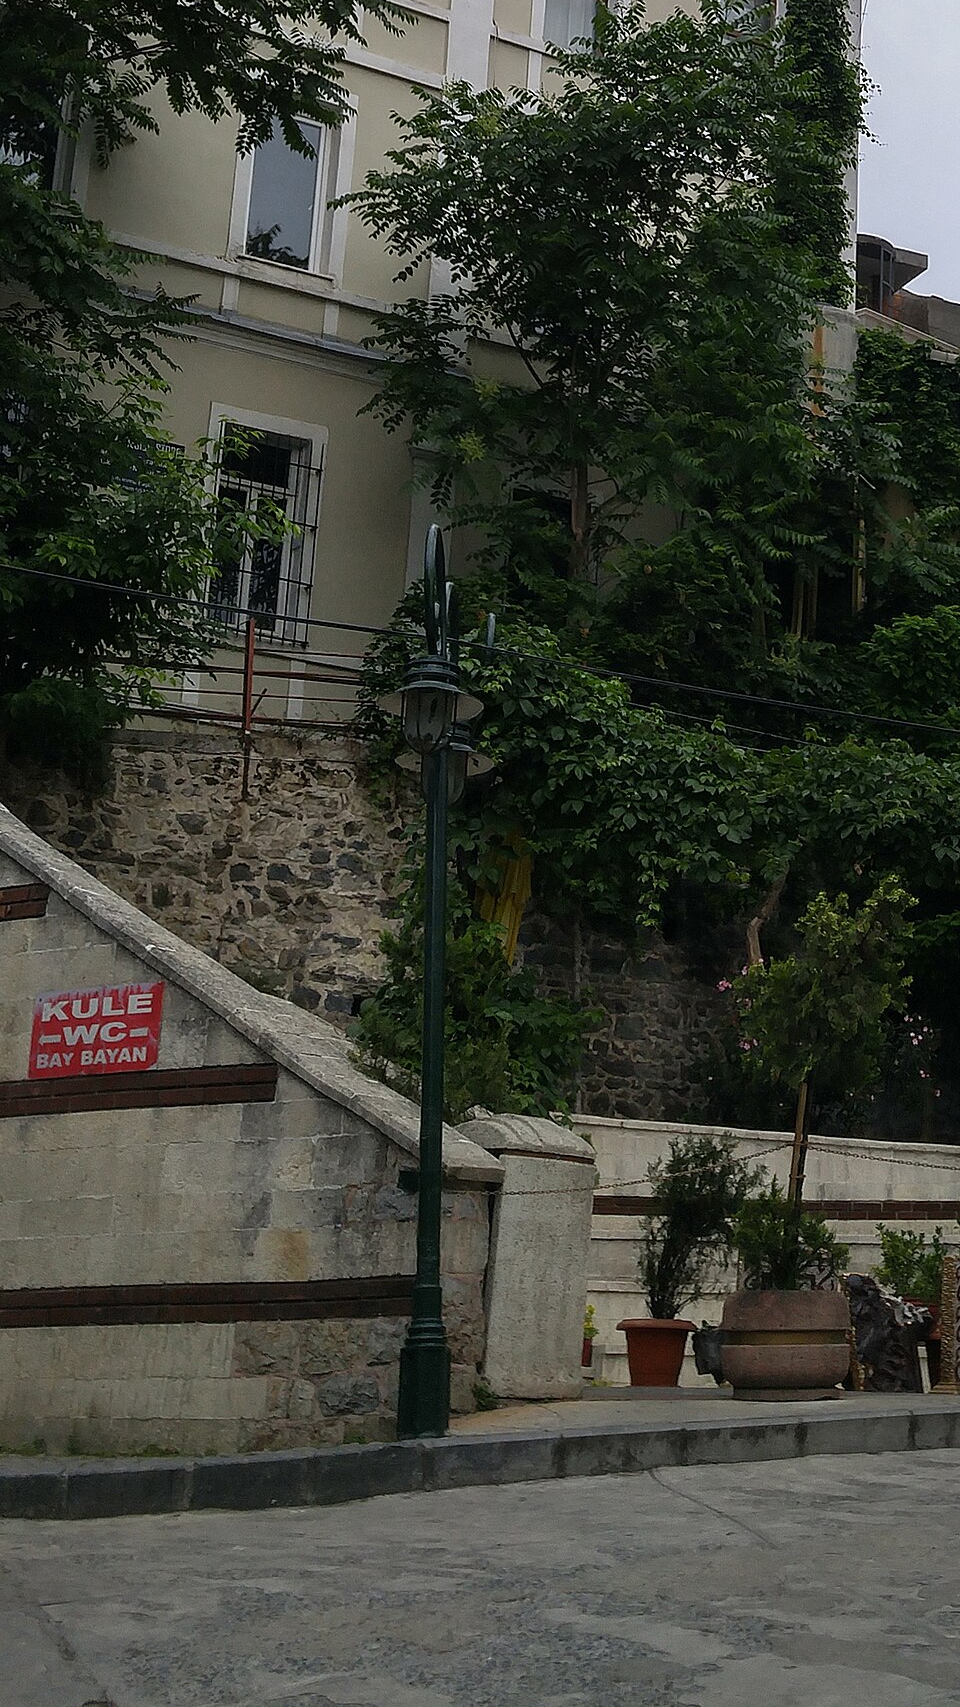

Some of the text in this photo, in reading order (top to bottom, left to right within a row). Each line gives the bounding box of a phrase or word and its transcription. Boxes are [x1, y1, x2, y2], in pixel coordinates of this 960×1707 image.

[41, 993, 154, 1023] KULE
[36, 1046, 147, 1069] BAY BAYAN
